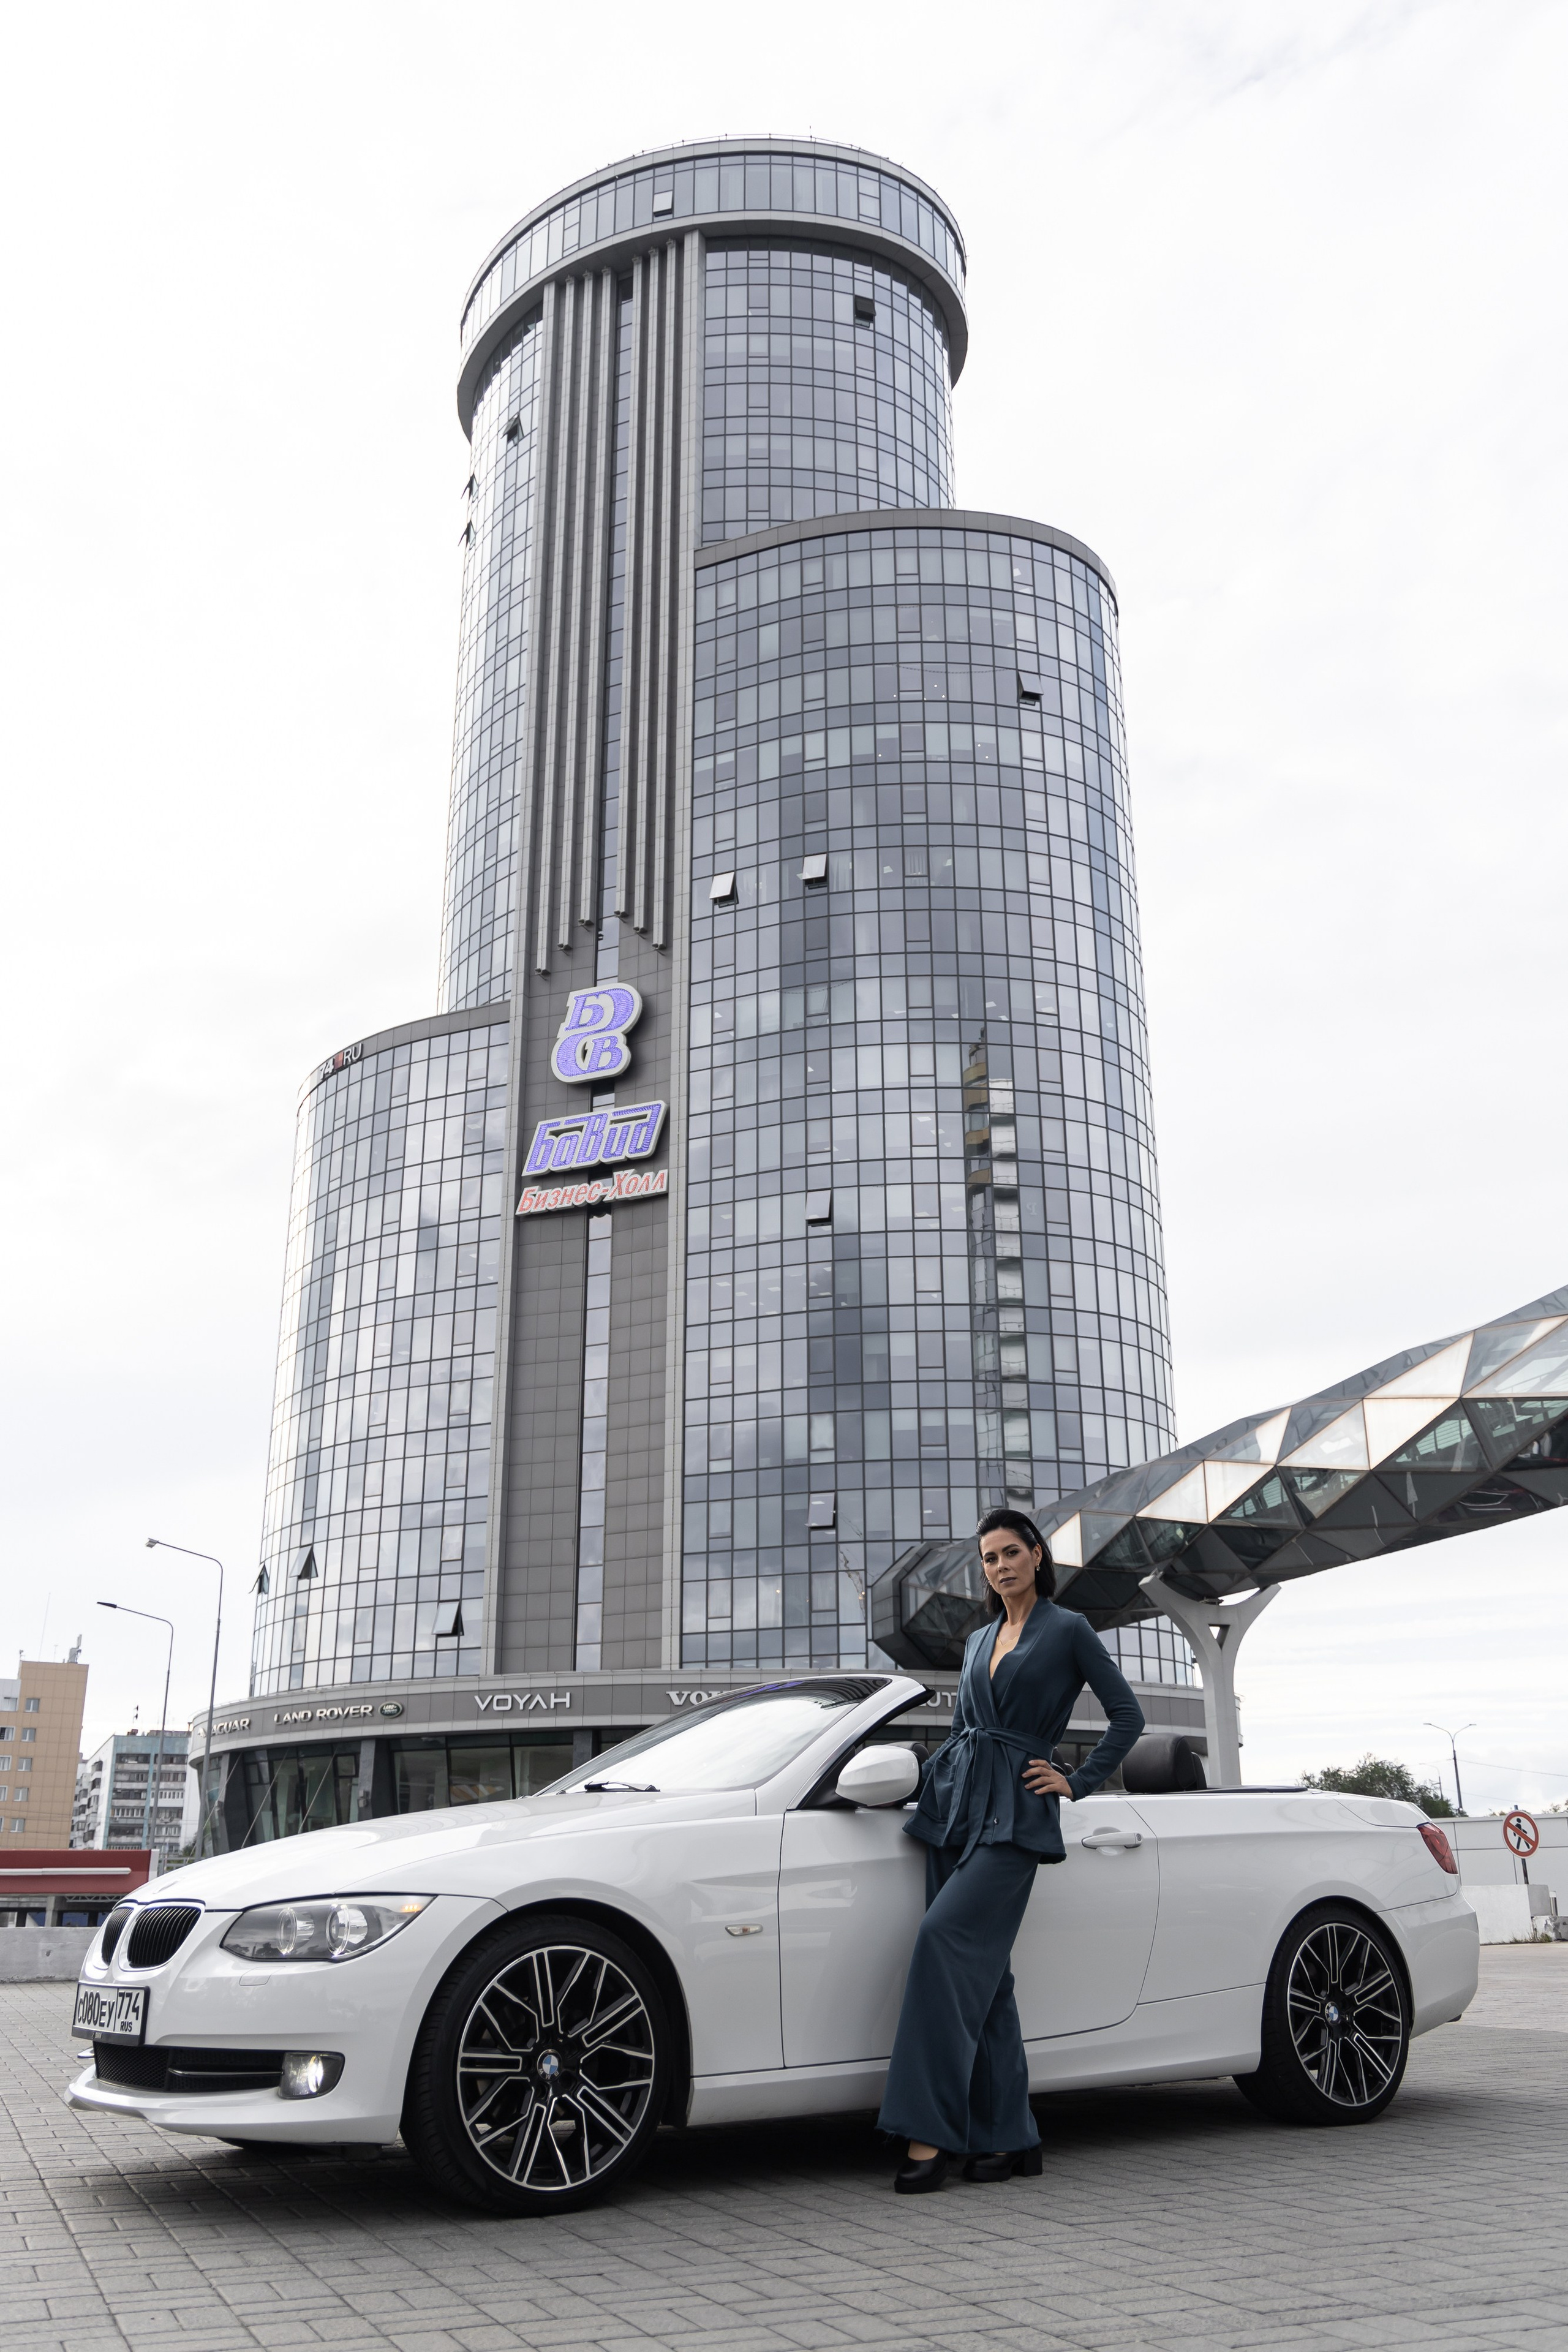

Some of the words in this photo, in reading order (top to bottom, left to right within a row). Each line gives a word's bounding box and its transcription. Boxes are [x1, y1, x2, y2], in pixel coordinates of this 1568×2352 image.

[518, 1172, 665, 1213] Бизнес-Холл
[474, 1691, 570, 1711] VOYAH
[274, 1709, 312, 1725] LAND
[315, 1704, 374, 1720] ROVER
[211, 1717, 250, 1736] AGUAR
[118, 1991, 140, 2021] 774
[120, 2020, 132, 2032] RUS
